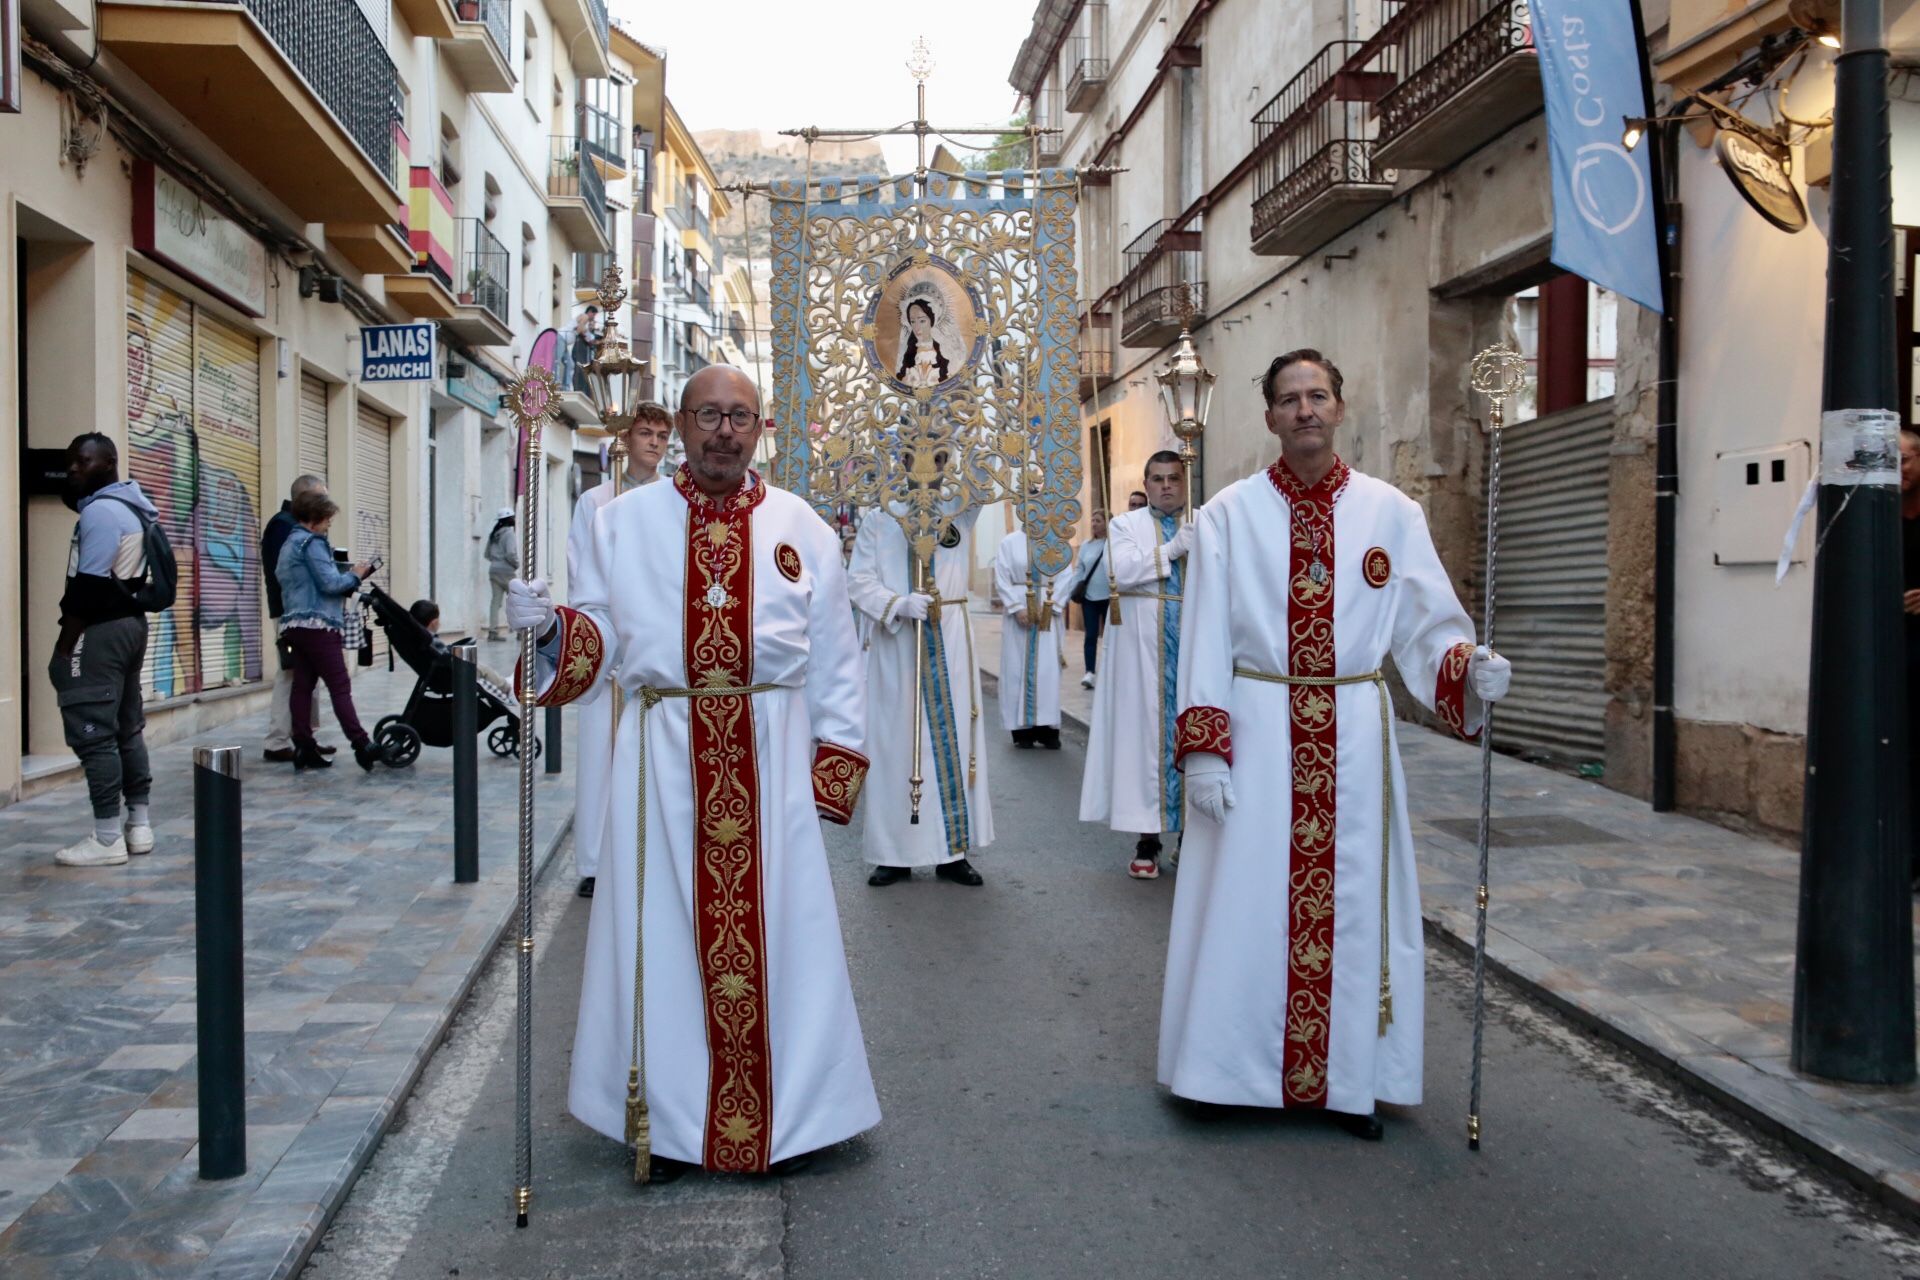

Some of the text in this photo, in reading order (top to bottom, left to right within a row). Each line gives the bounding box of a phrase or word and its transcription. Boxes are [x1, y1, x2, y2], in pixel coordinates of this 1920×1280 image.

[364, 327, 430, 358] LANAS
[365, 362, 430, 379] CONCHI
[72, 656, 81, 677] KING
